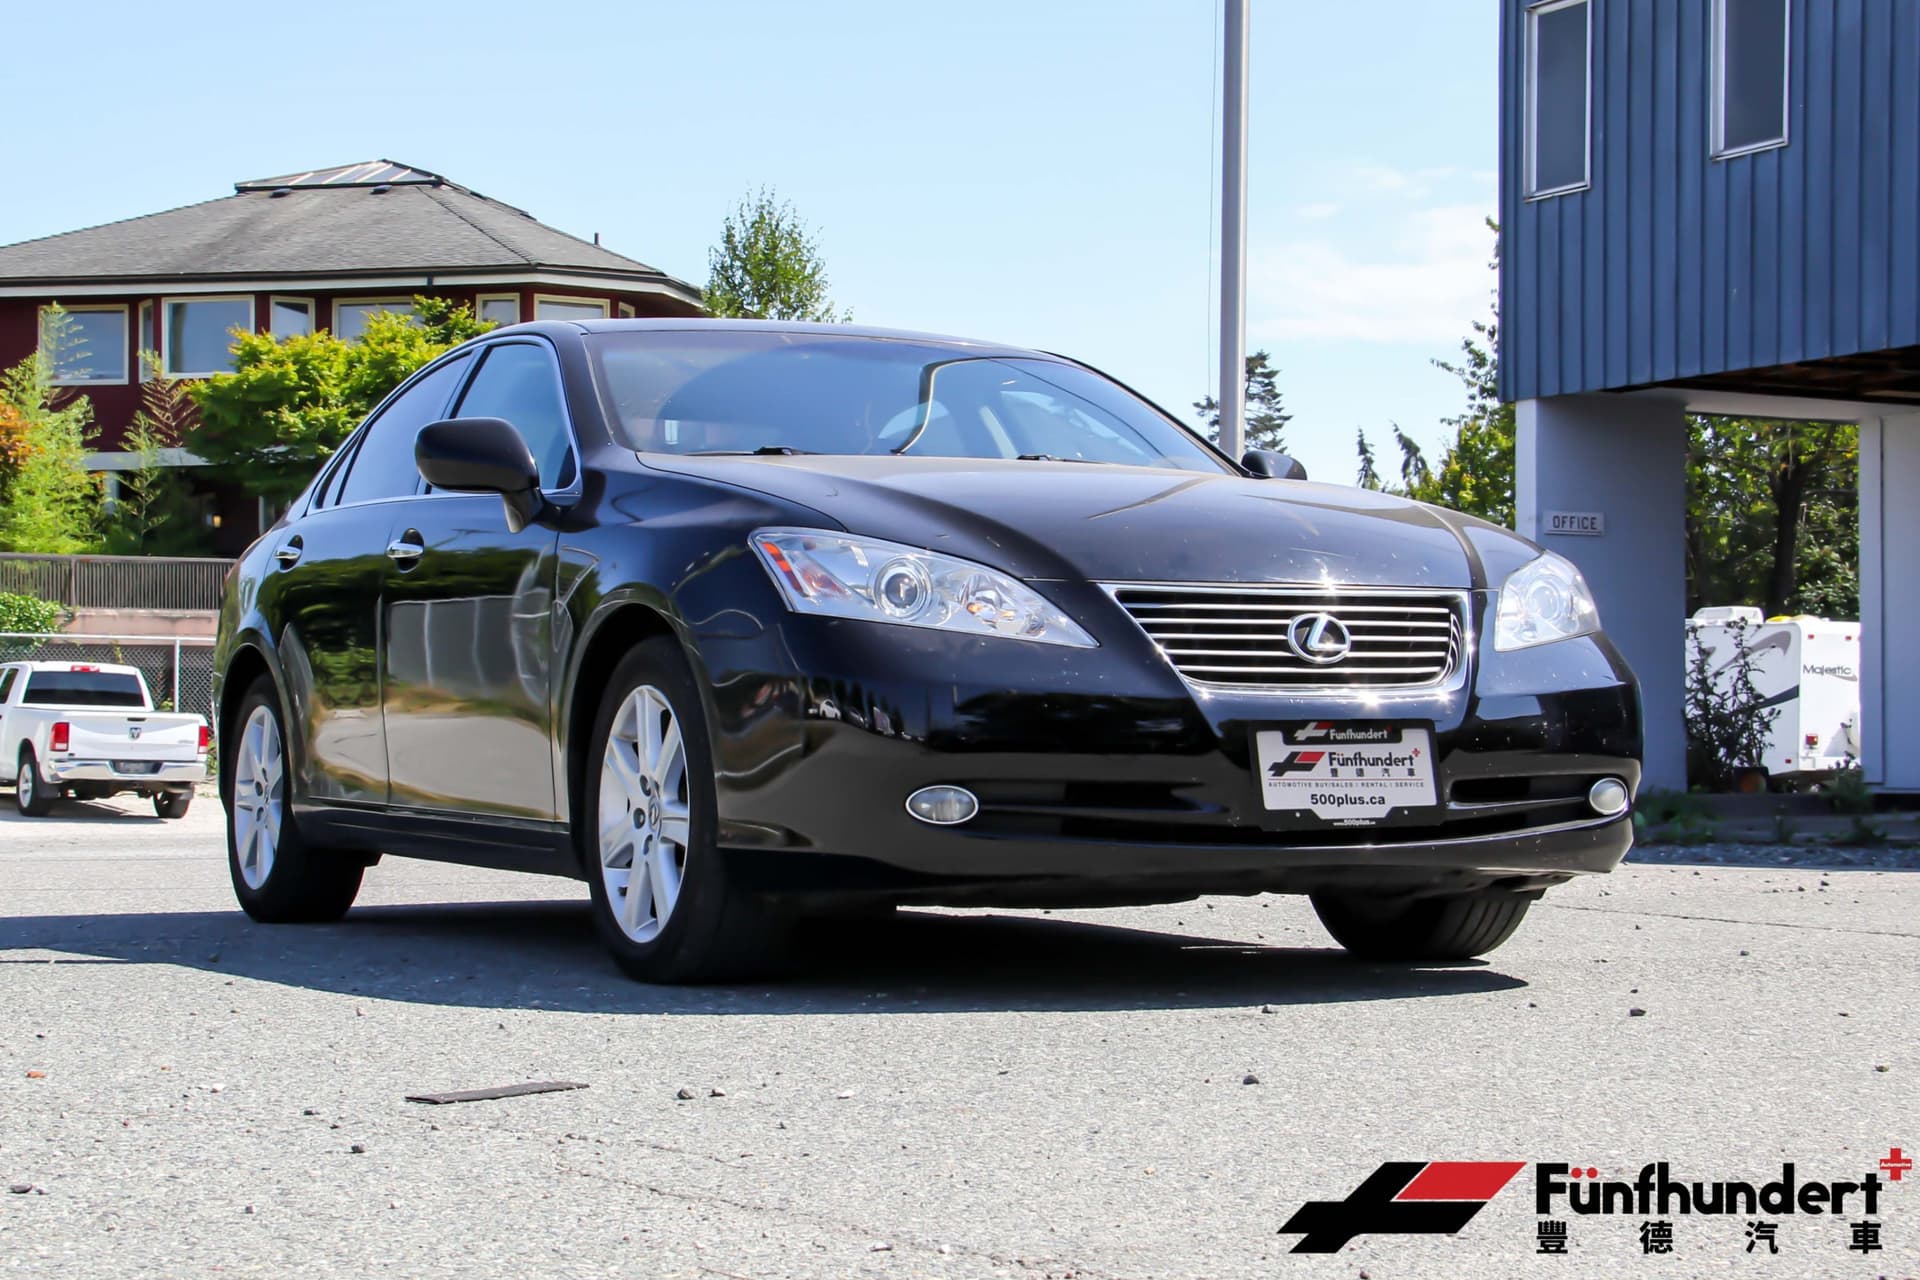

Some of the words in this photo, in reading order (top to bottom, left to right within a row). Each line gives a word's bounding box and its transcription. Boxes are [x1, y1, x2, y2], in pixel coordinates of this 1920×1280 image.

[1552, 515, 1598, 530] OFFICE
[1802, 664, 1852, 676] Majestic
[1328, 751, 1414, 767] Fünfhundert
[1310, 793, 1386, 808] 500plus.ca
